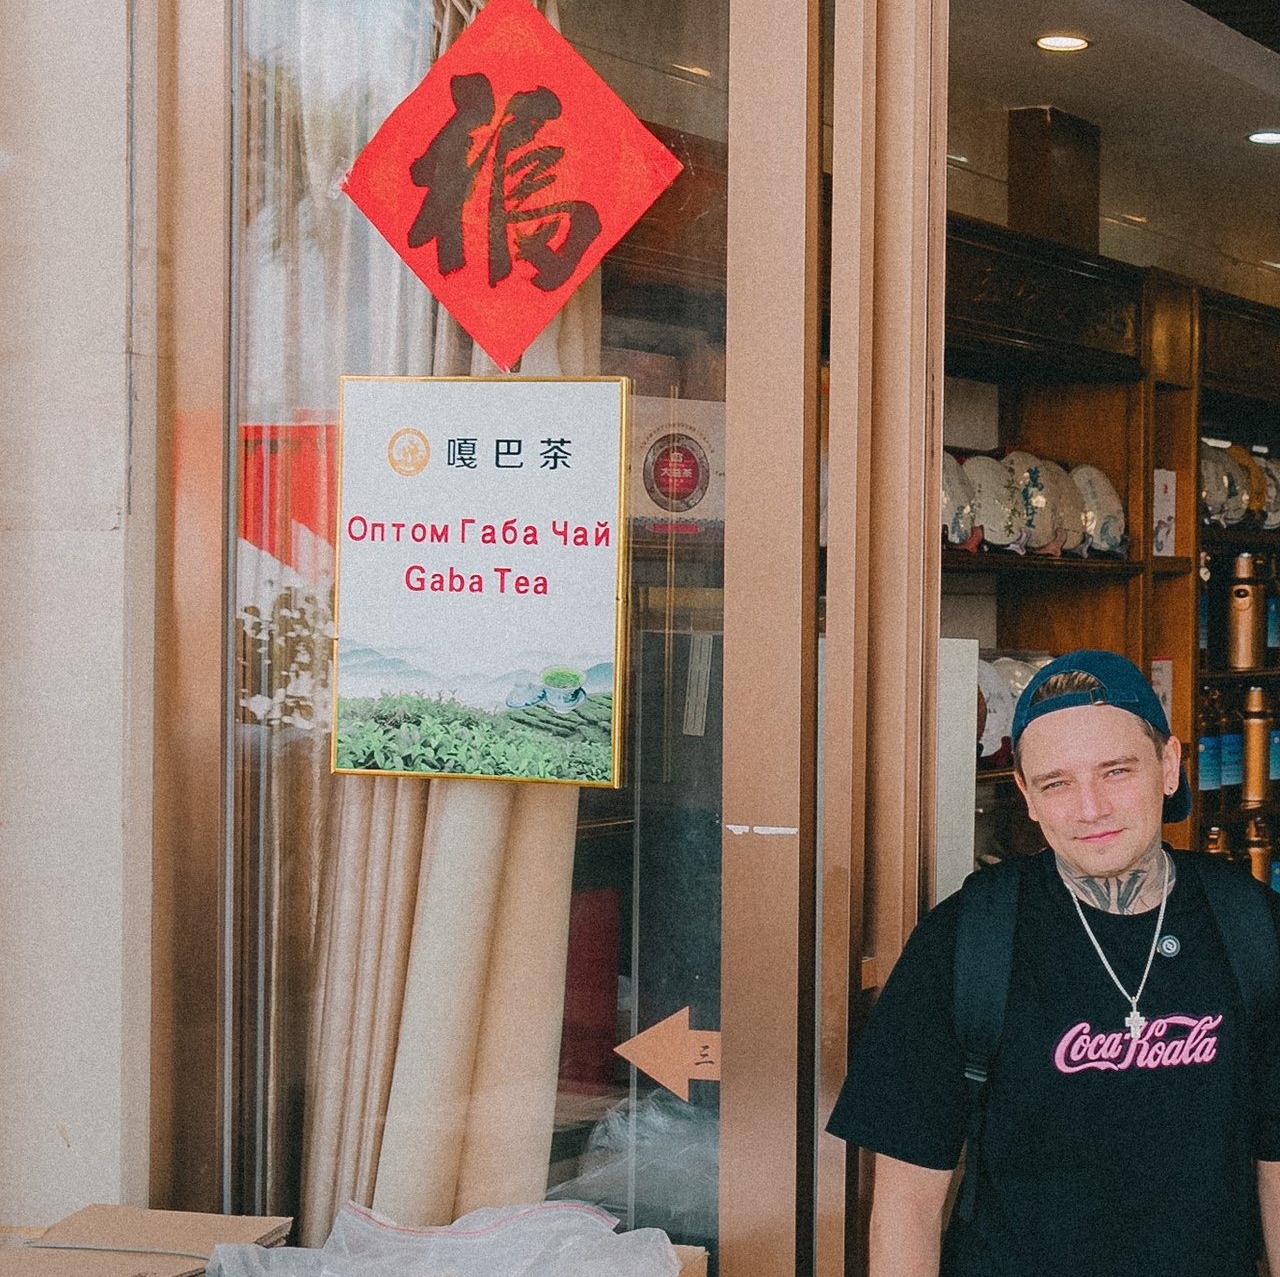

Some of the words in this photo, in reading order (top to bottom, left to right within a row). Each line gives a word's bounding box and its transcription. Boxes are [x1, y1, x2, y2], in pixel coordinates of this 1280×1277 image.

[407, 72, 603, 293] 福
[446, 436, 573, 471] 嘎巴茶
[347, 515, 450, 544] Оптом
[460, 518, 539, 546] Габа
[551, 520, 611, 547] Чай
[404, 564, 484, 593] Gaba
[493, 567, 549, 595] Tea
